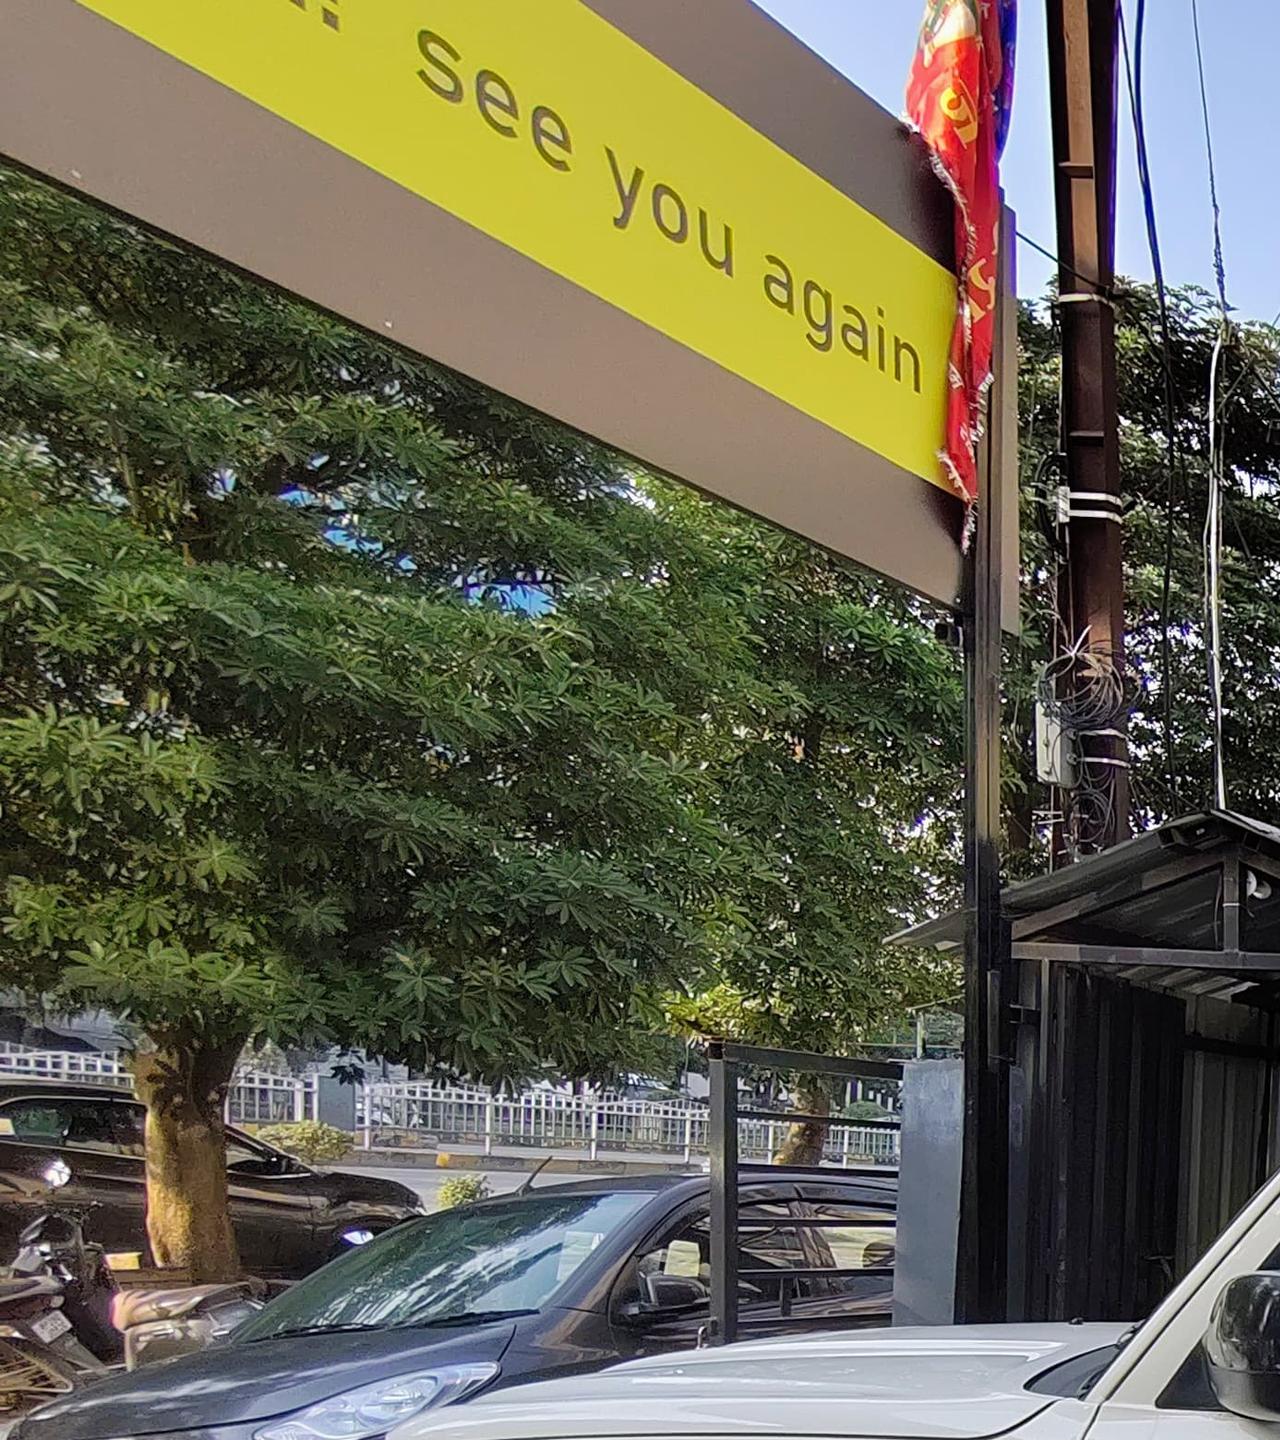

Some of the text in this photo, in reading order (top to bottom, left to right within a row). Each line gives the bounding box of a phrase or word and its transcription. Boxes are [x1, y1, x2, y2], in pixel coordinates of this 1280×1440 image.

[416, 28, 573, 173] see
[604, 143, 734, 279] you
[763, 253, 922, 394] again
